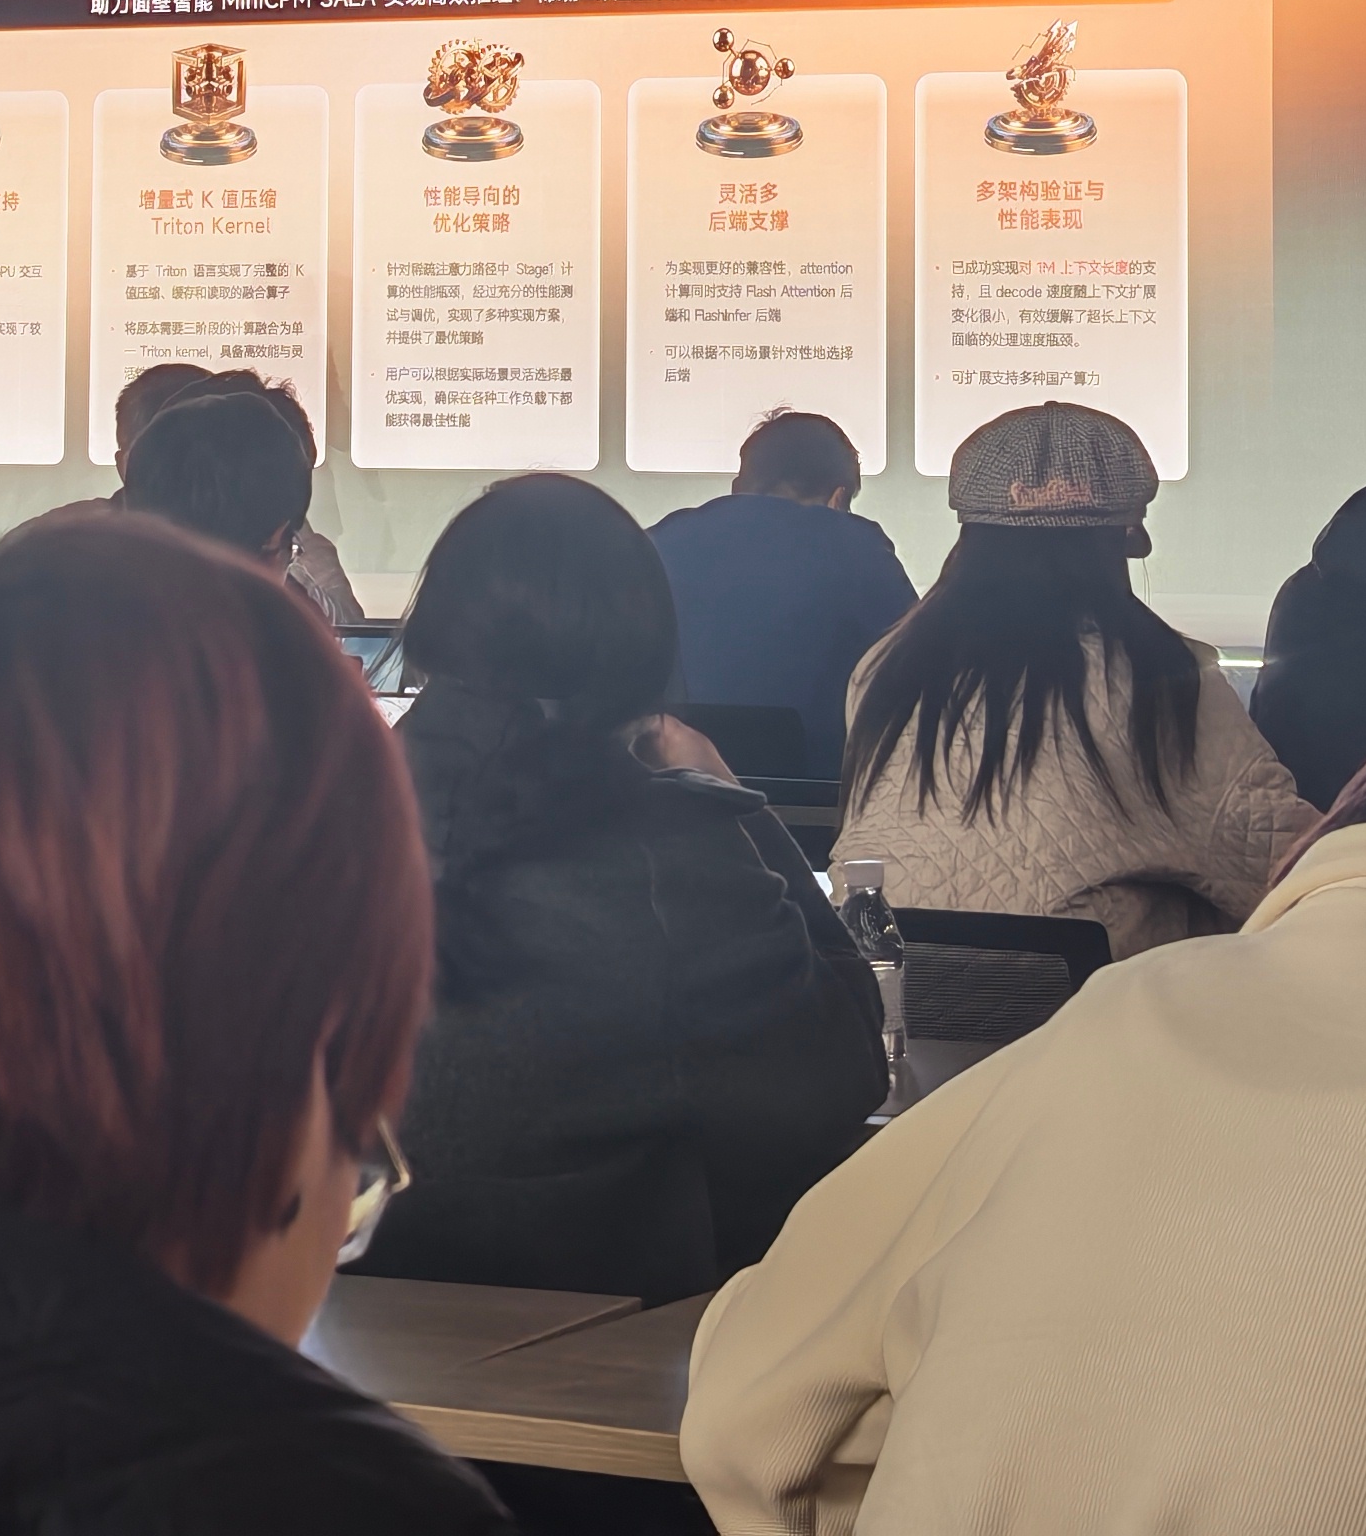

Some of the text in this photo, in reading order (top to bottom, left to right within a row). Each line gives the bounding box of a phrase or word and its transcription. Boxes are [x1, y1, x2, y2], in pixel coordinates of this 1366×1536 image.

[139, 189, 276, 209] 增量式 K 值压缩
[424, 185, 520, 207] 性能导向的
[719, 182, 778, 204] 灵活多
[976, 180, 1104, 202] 多架构验证与
[152, 216, 270, 234] Triton Kernel
[433, 213, 510, 233] 优化策略
[709, 210, 789, 231] 后端支撑
[998, 209, 1083, 230] 性能表现
[19, 265, 42, 278] 交互
[746, 285, 776, 298] Flash
[781, 285, 835, 298] Attention
[996, 285, 1042, 298] decode
